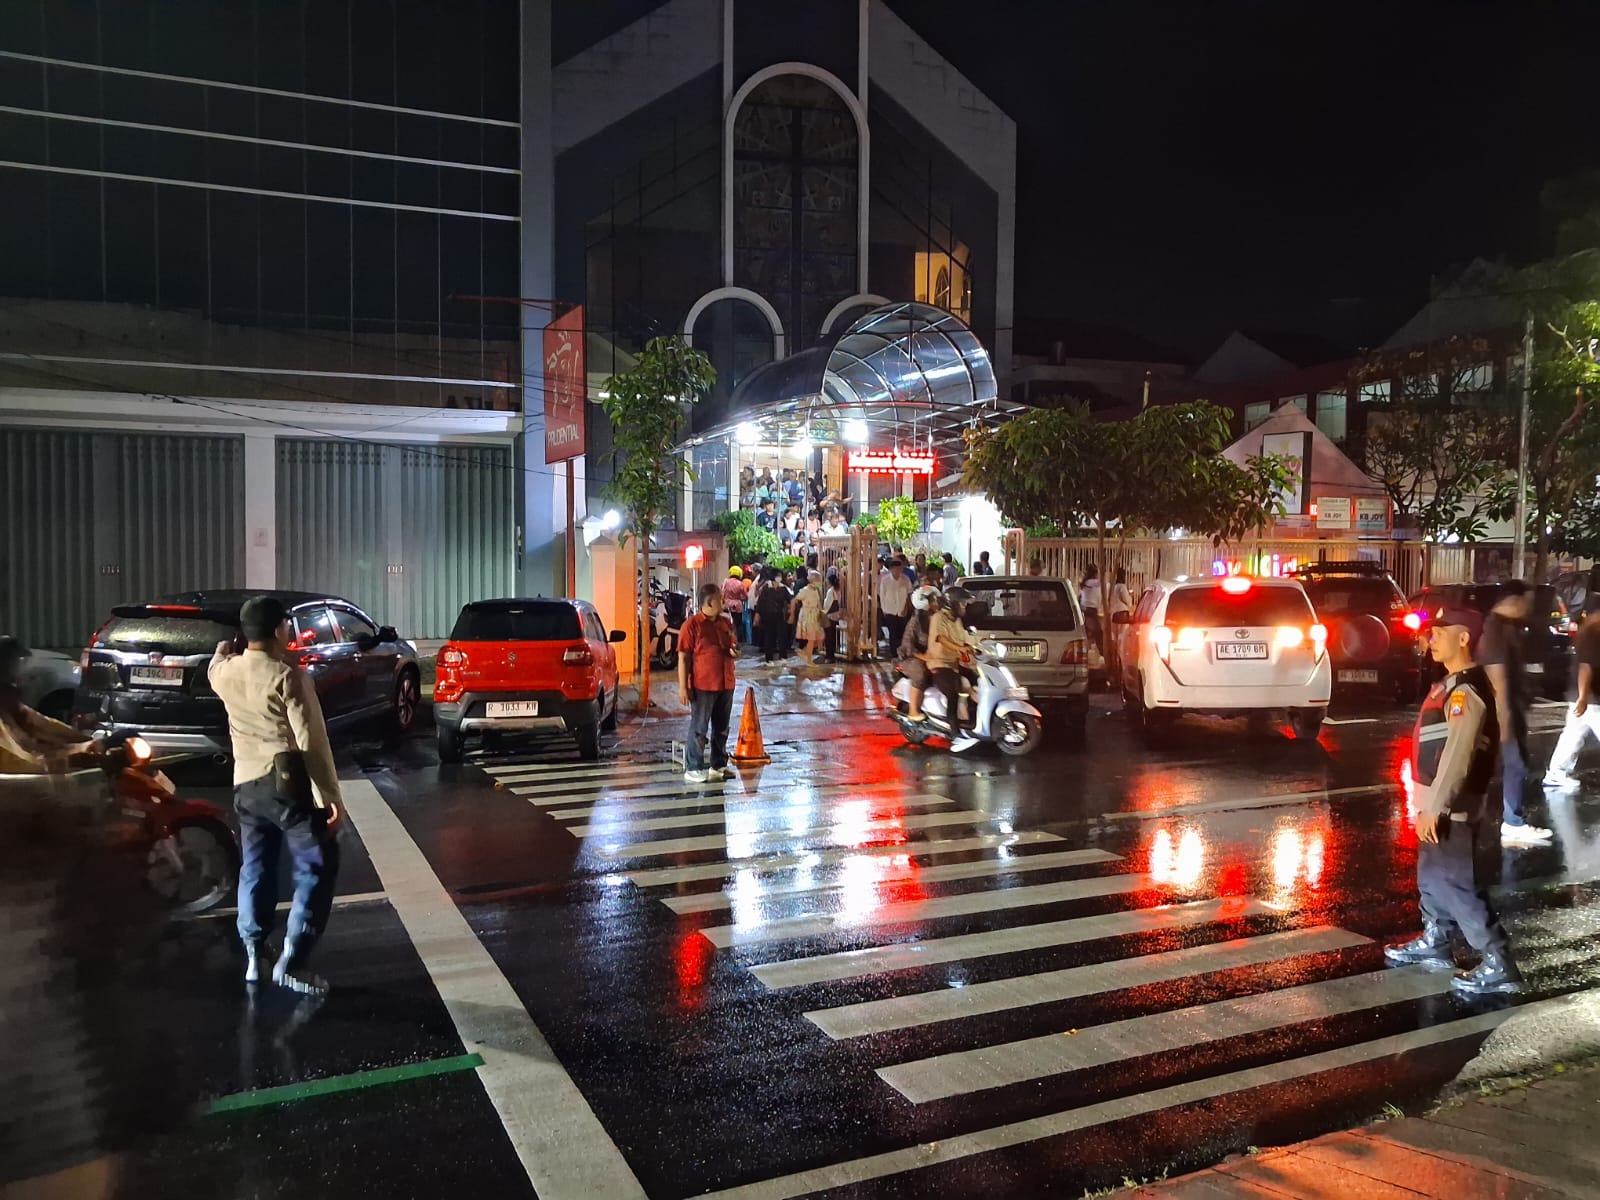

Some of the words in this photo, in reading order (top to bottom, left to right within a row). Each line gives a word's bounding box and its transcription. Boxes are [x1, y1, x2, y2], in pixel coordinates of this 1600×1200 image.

[548, 424, 579, 448] PRUDENTIAL
[1220, 645, 1230, 653] AE
[132, 668, 142, 678] AE
[487, 703, 494, 712] R
